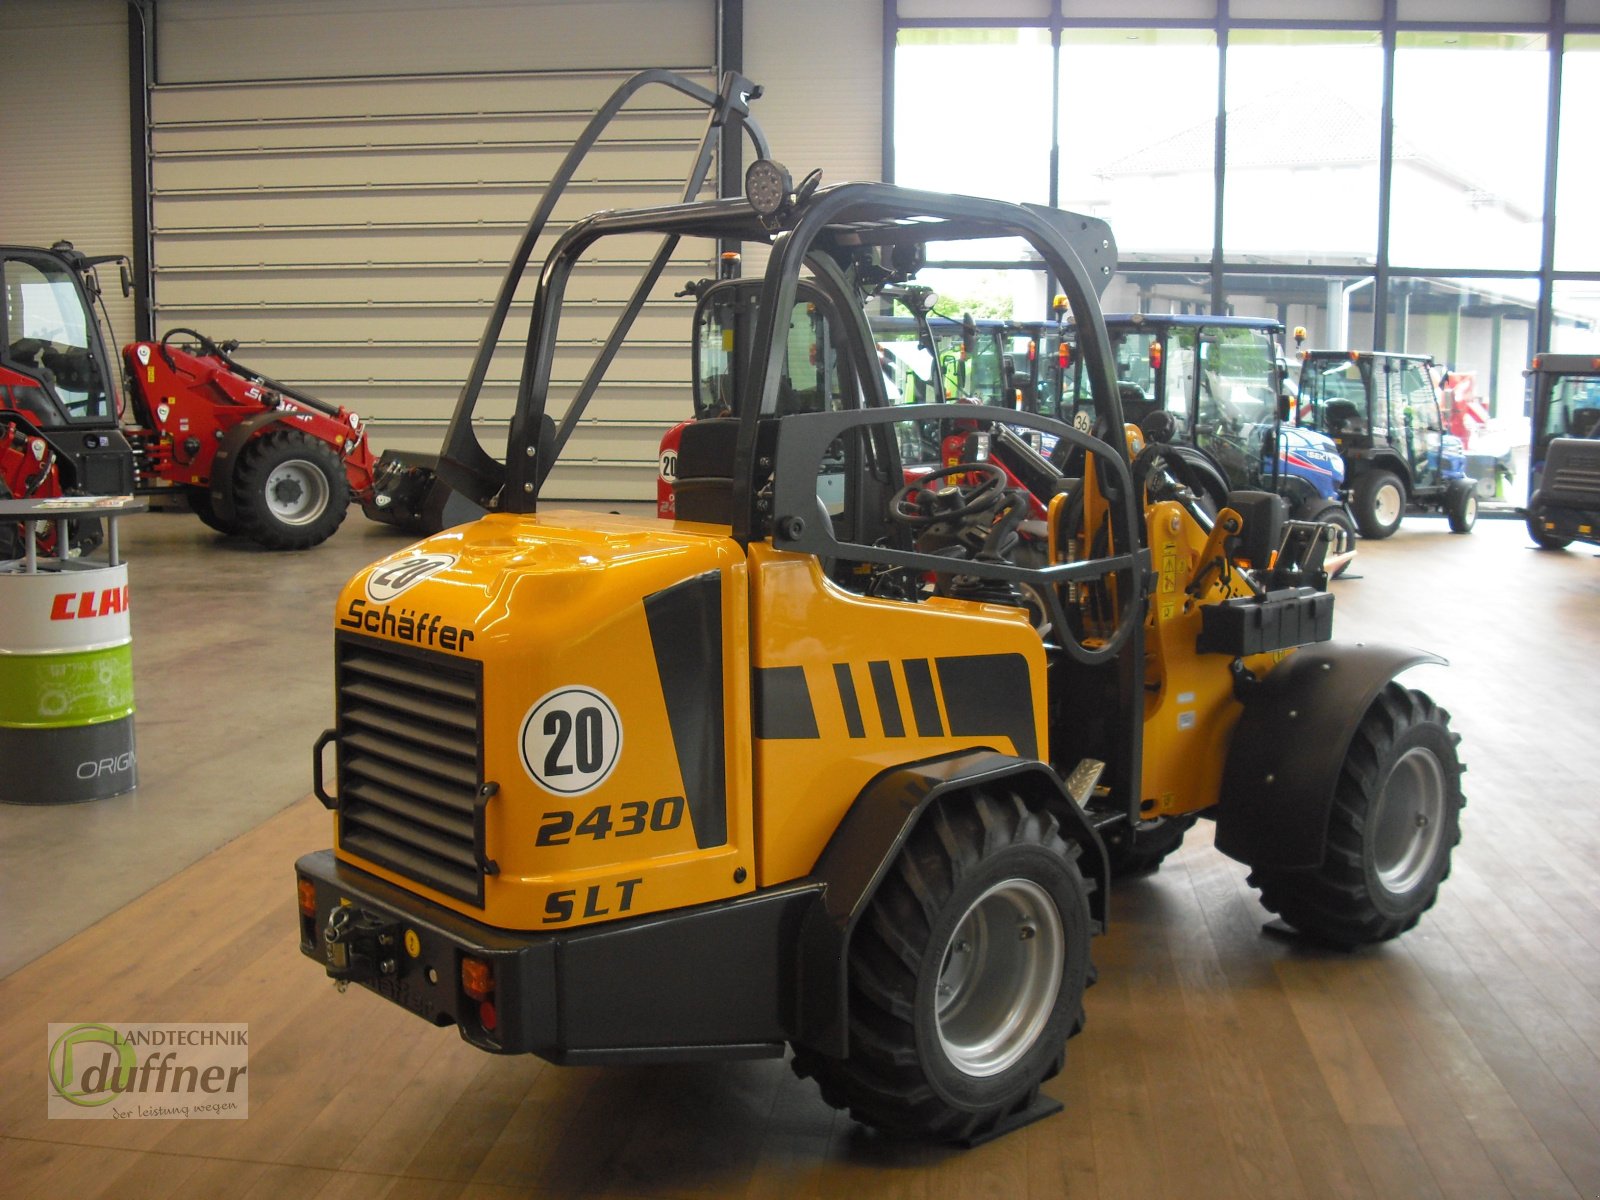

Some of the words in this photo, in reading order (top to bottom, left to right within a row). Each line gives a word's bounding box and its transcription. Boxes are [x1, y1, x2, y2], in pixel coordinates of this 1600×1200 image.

[373, 558, 445, 589] 20
[341, 599, 475, 652] Schäffer
[543, 706, 604, 777] 20
[534, 796, 685, 847] 2430
[542, 878, 643, 924] SLT
